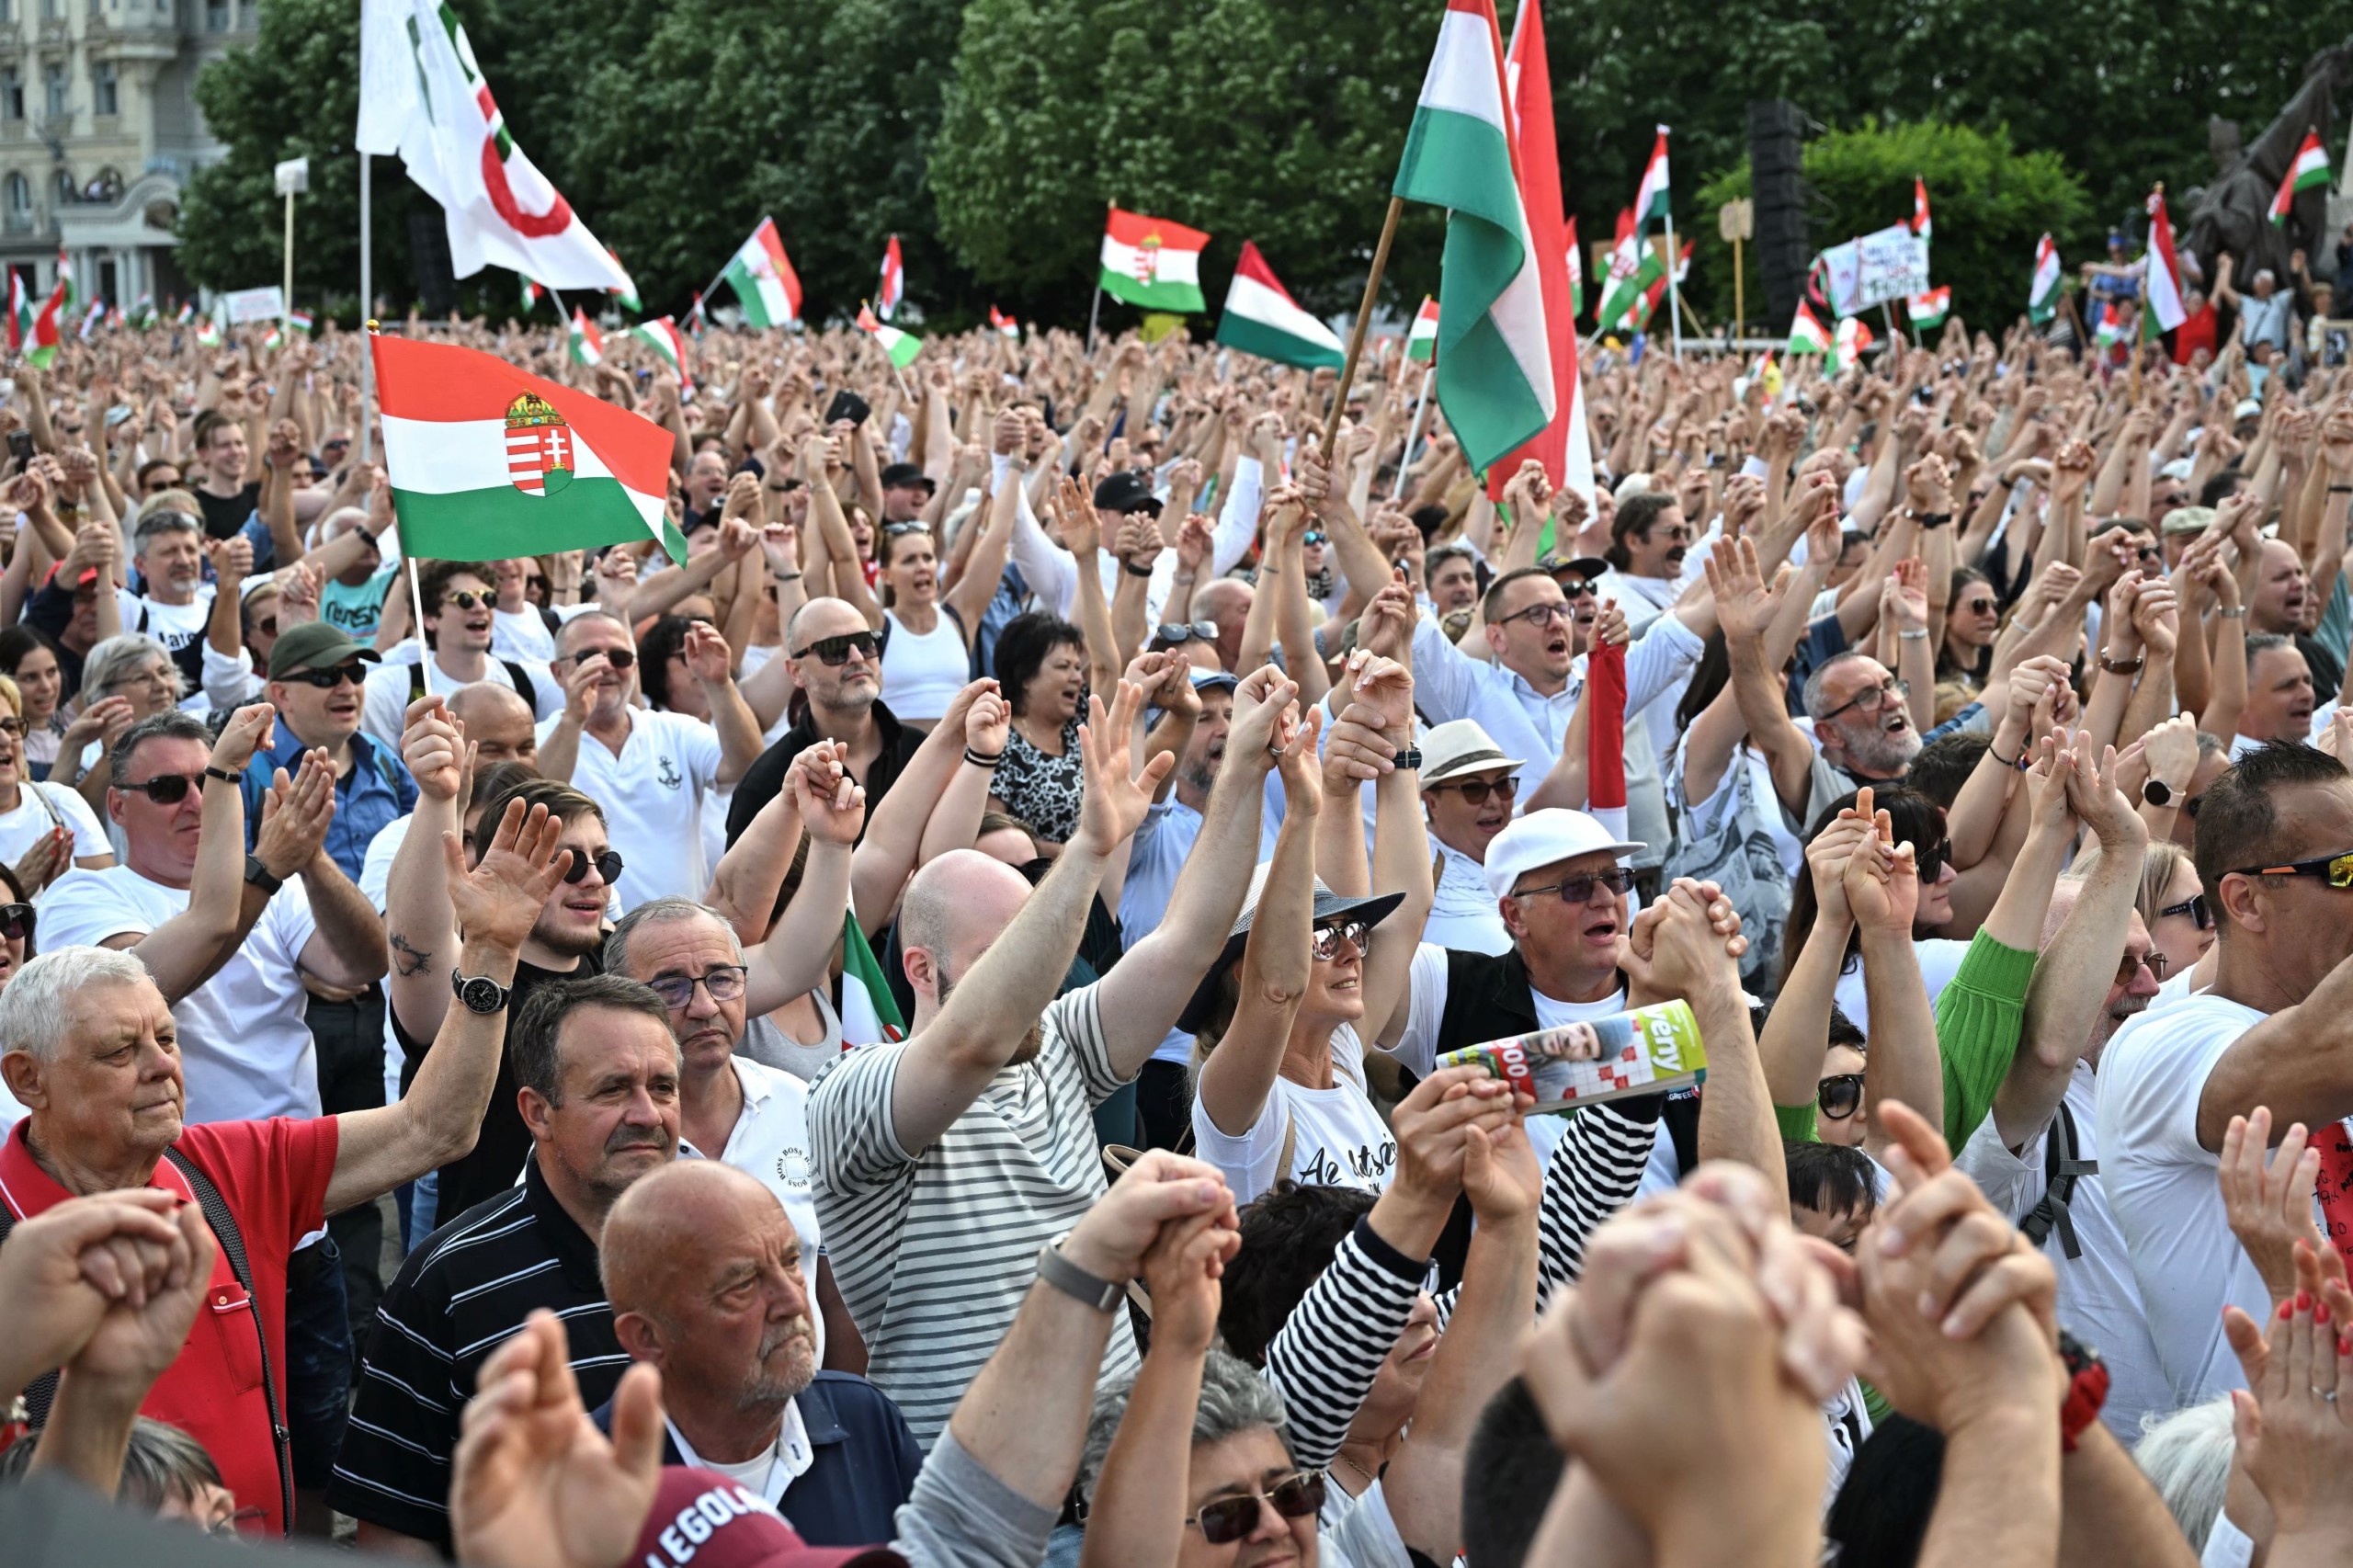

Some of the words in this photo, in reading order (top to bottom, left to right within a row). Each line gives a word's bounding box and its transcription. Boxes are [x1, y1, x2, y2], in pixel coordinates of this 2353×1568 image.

[782, 1146, 803, 1157] BOSS
[777, 1156, 787, 1181] BOSS
[788, 1178, 809, 1188] BOSS
